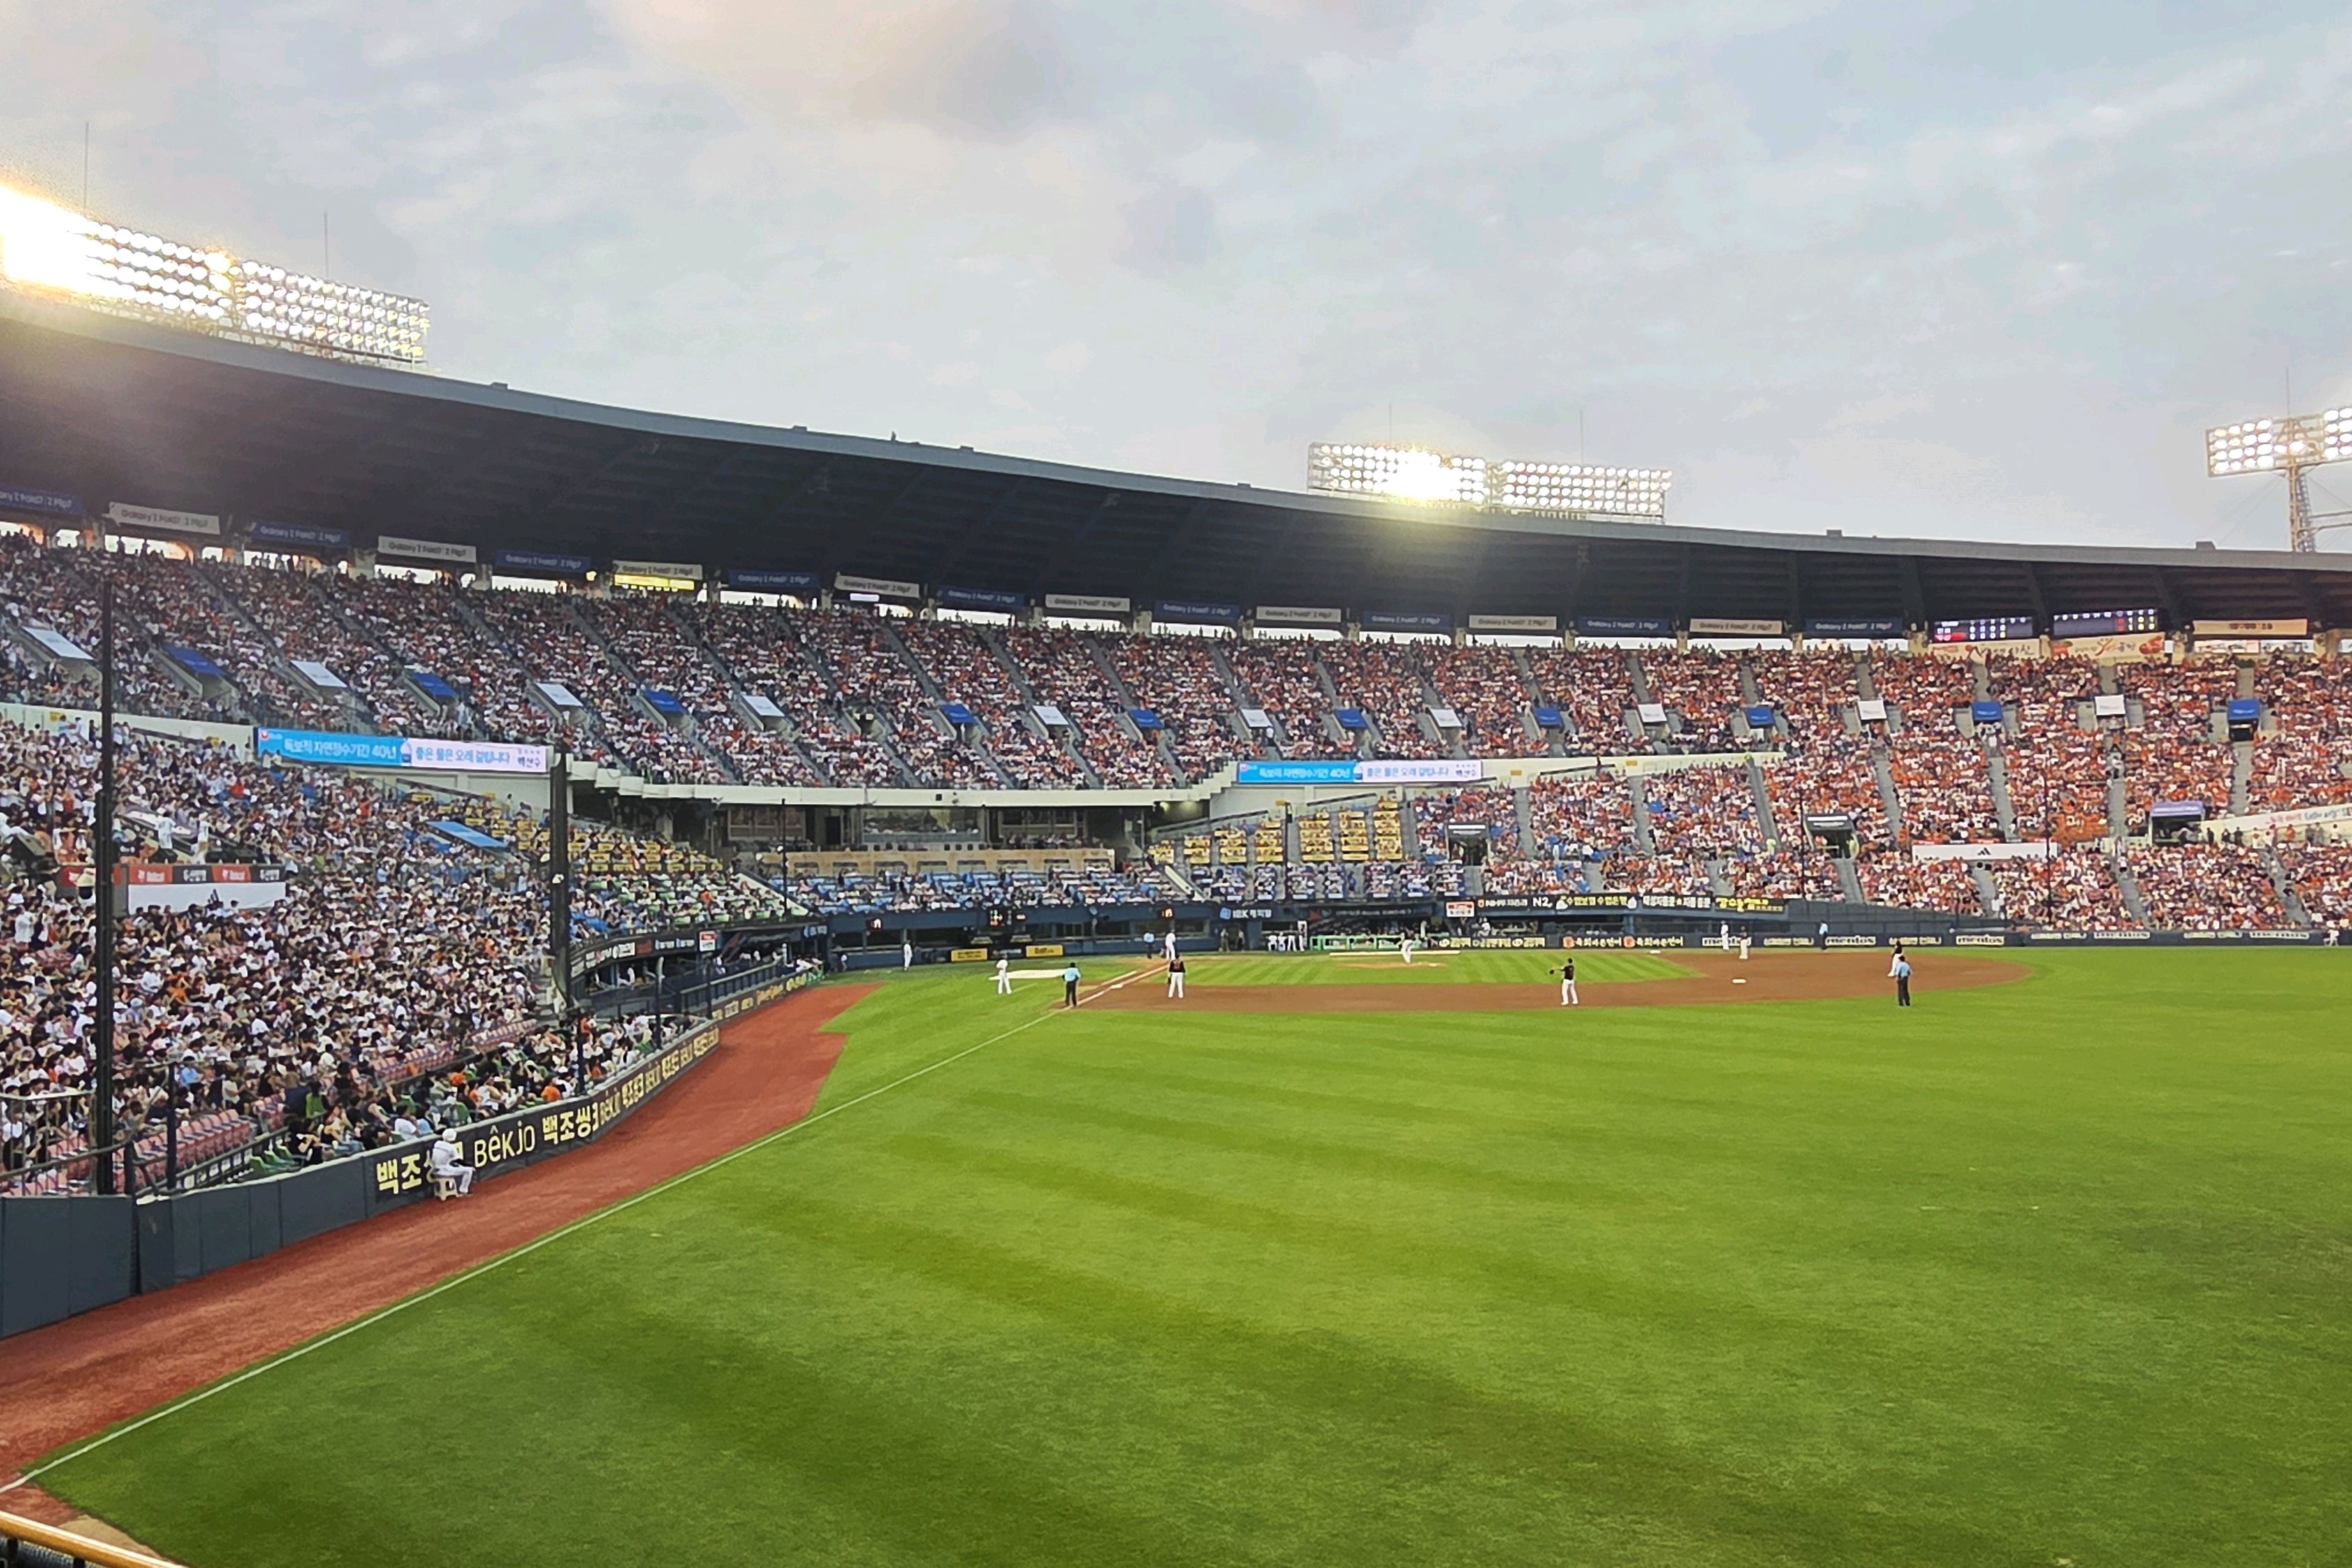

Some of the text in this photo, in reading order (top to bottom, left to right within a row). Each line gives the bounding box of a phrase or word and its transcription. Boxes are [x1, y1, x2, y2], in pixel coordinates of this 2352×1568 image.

[372, 744, 397, 760] 40년
[455, 749, 473, 763] 오래
[1826, 935, 1876, 946] mentos
[1955, 934, 2005, 946] mentos
